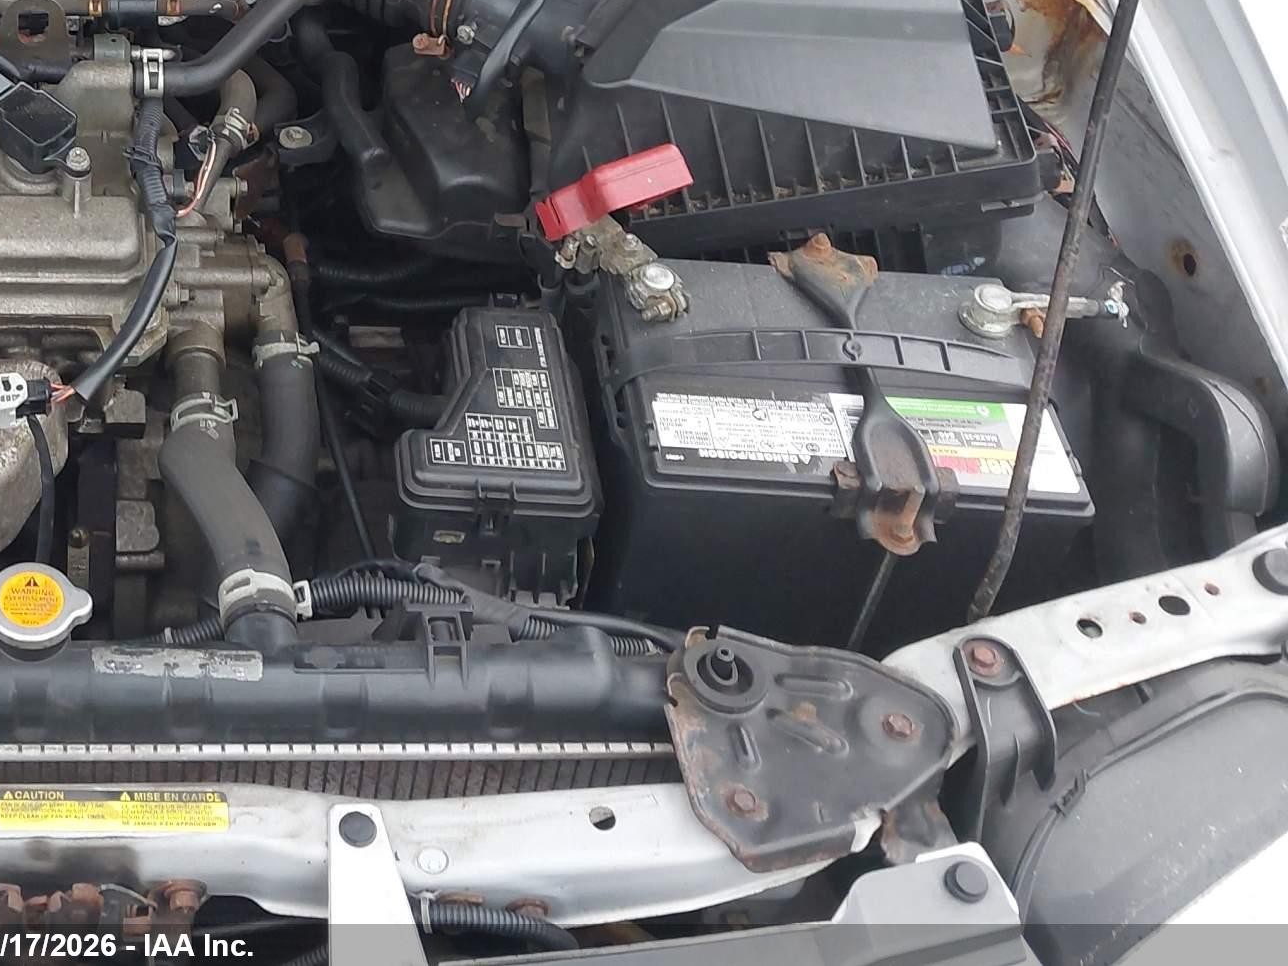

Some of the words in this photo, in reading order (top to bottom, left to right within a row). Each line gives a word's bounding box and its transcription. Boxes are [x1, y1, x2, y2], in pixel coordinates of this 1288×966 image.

[15, 790, 64, 800] CAUTION
[134, 792, 161, 802] MISE
[164, 792, 179, 802] EN
[182, 792, 221, 802] GARDE
